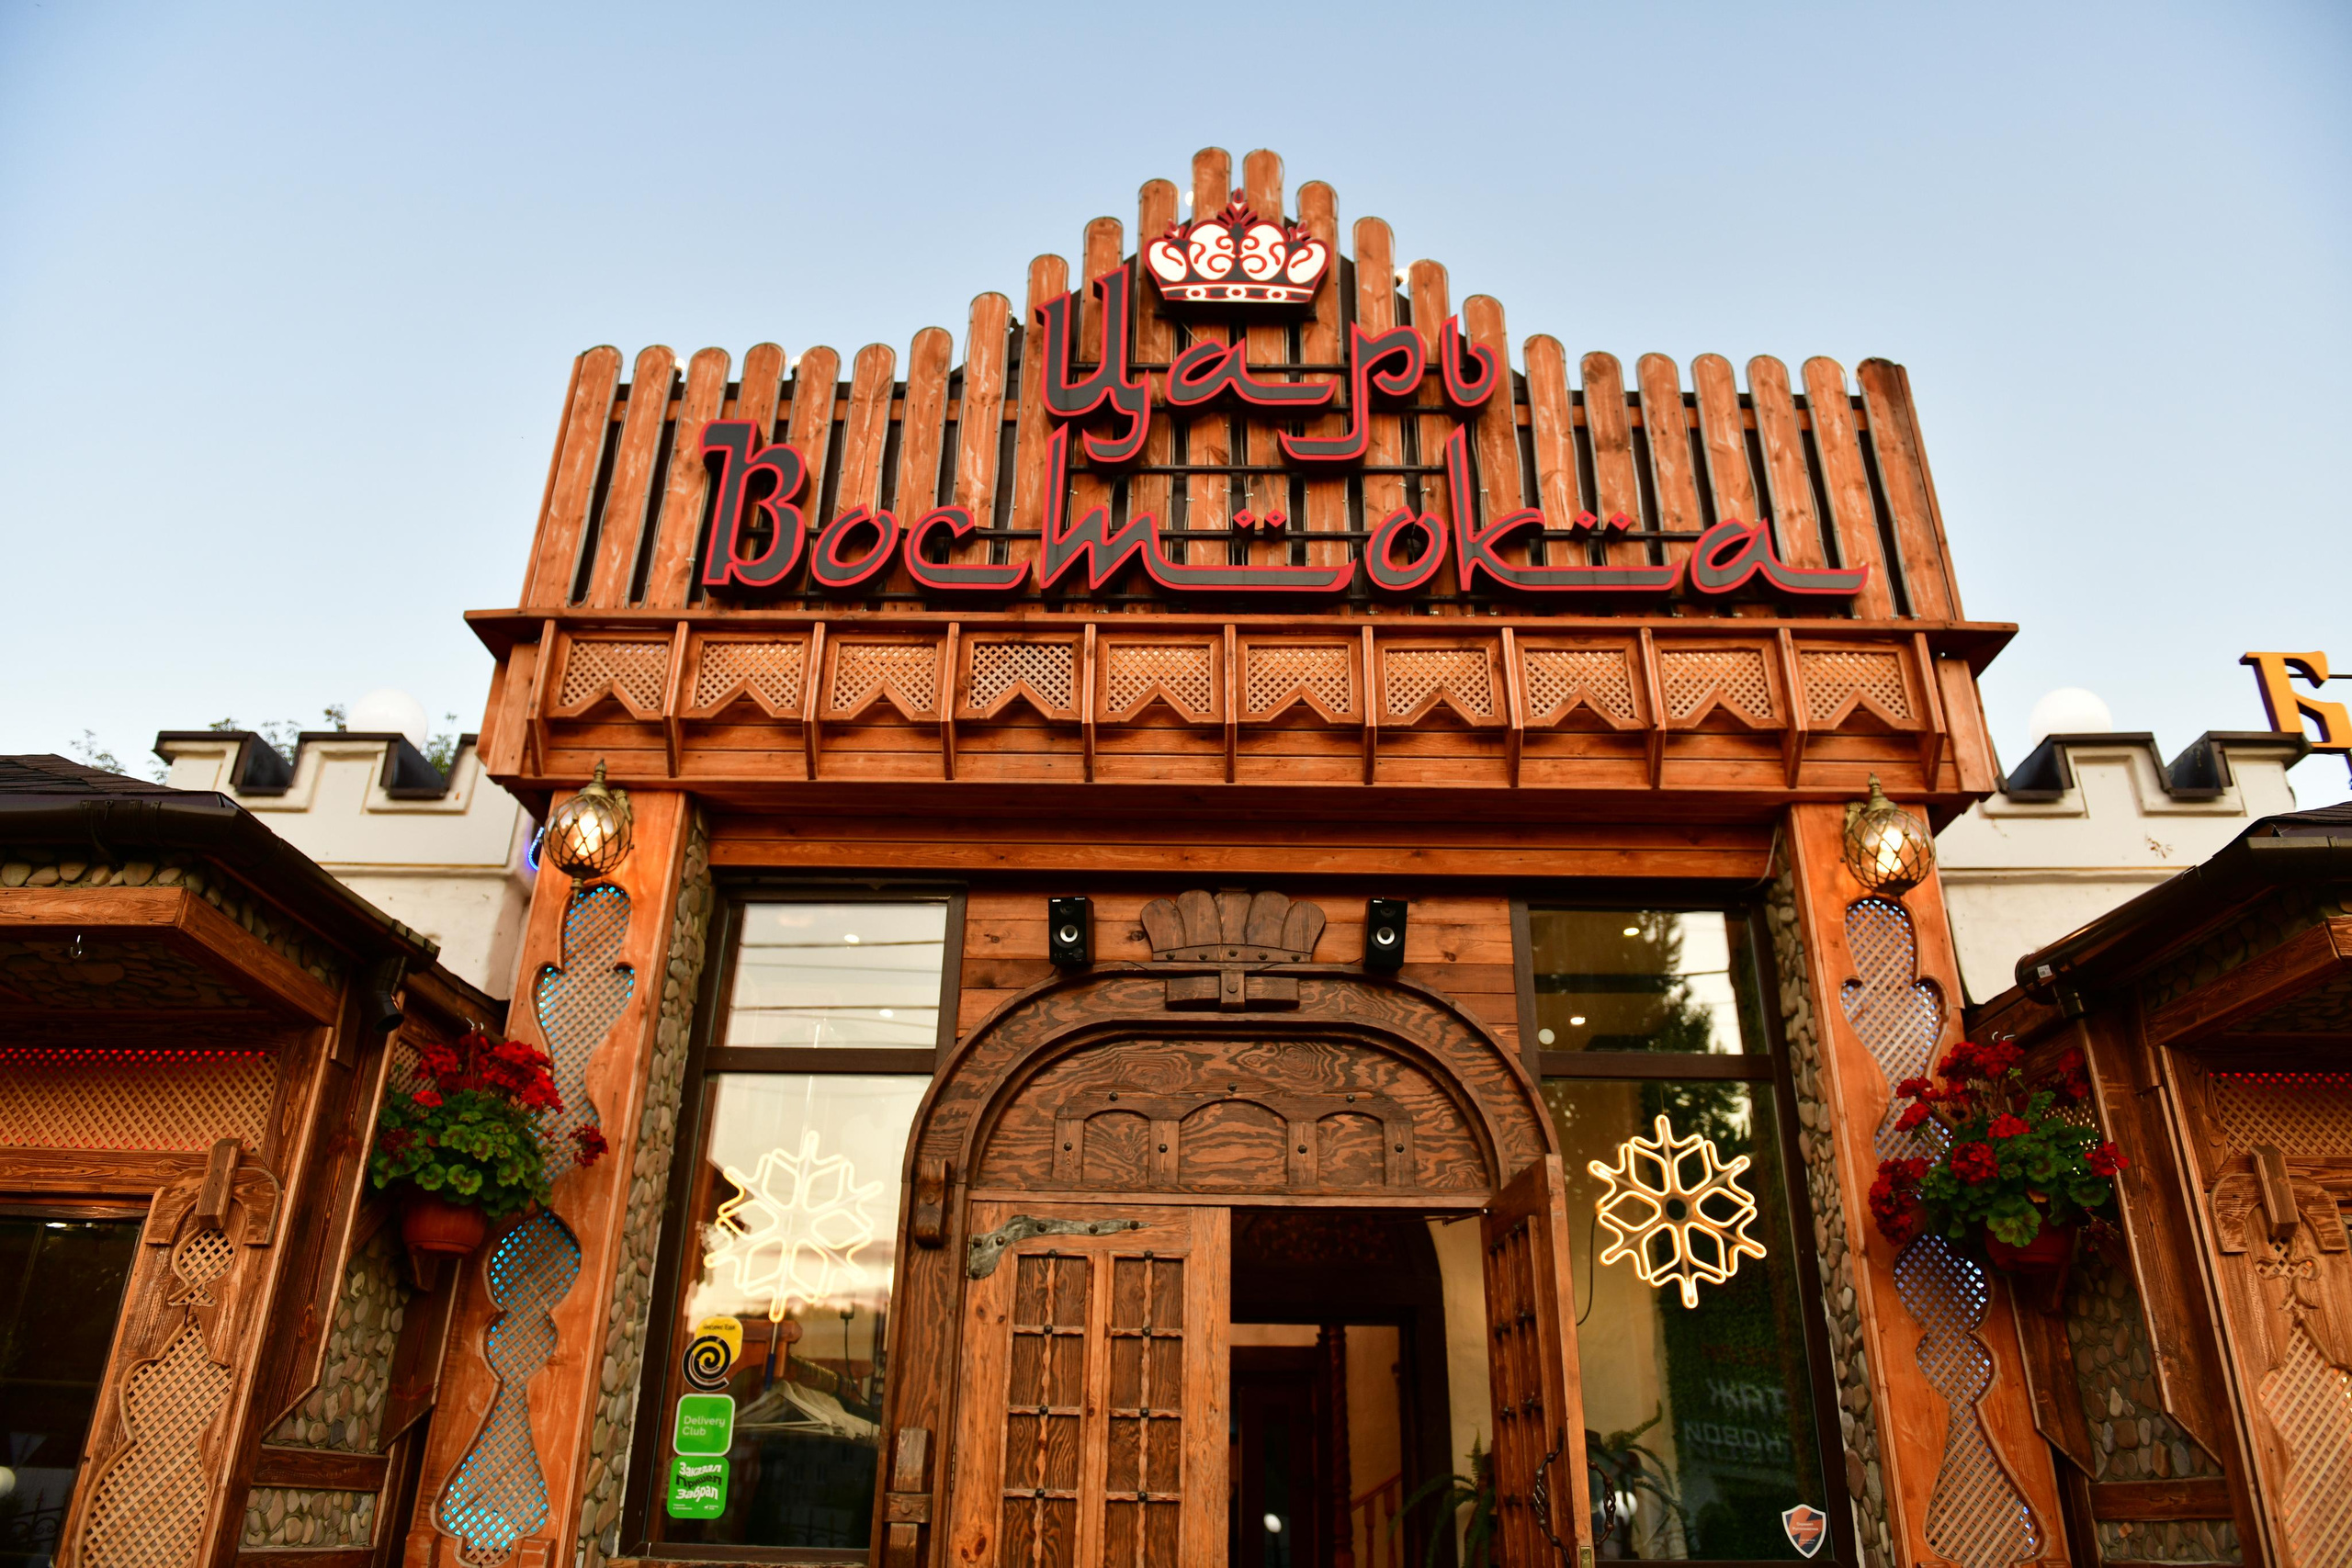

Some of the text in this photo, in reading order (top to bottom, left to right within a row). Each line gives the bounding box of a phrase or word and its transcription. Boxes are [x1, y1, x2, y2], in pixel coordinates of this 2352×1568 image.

[1035, 265, 1500, 464] Царь
[699, 418, 1870, 598] Востока
[684, 1416, 726, 1428] Delivery
[682, 1426, 707, 1437] Club
[679, 1461, 722, 1477] Заказал
[675, 1485, 718, 1503] Забрал
